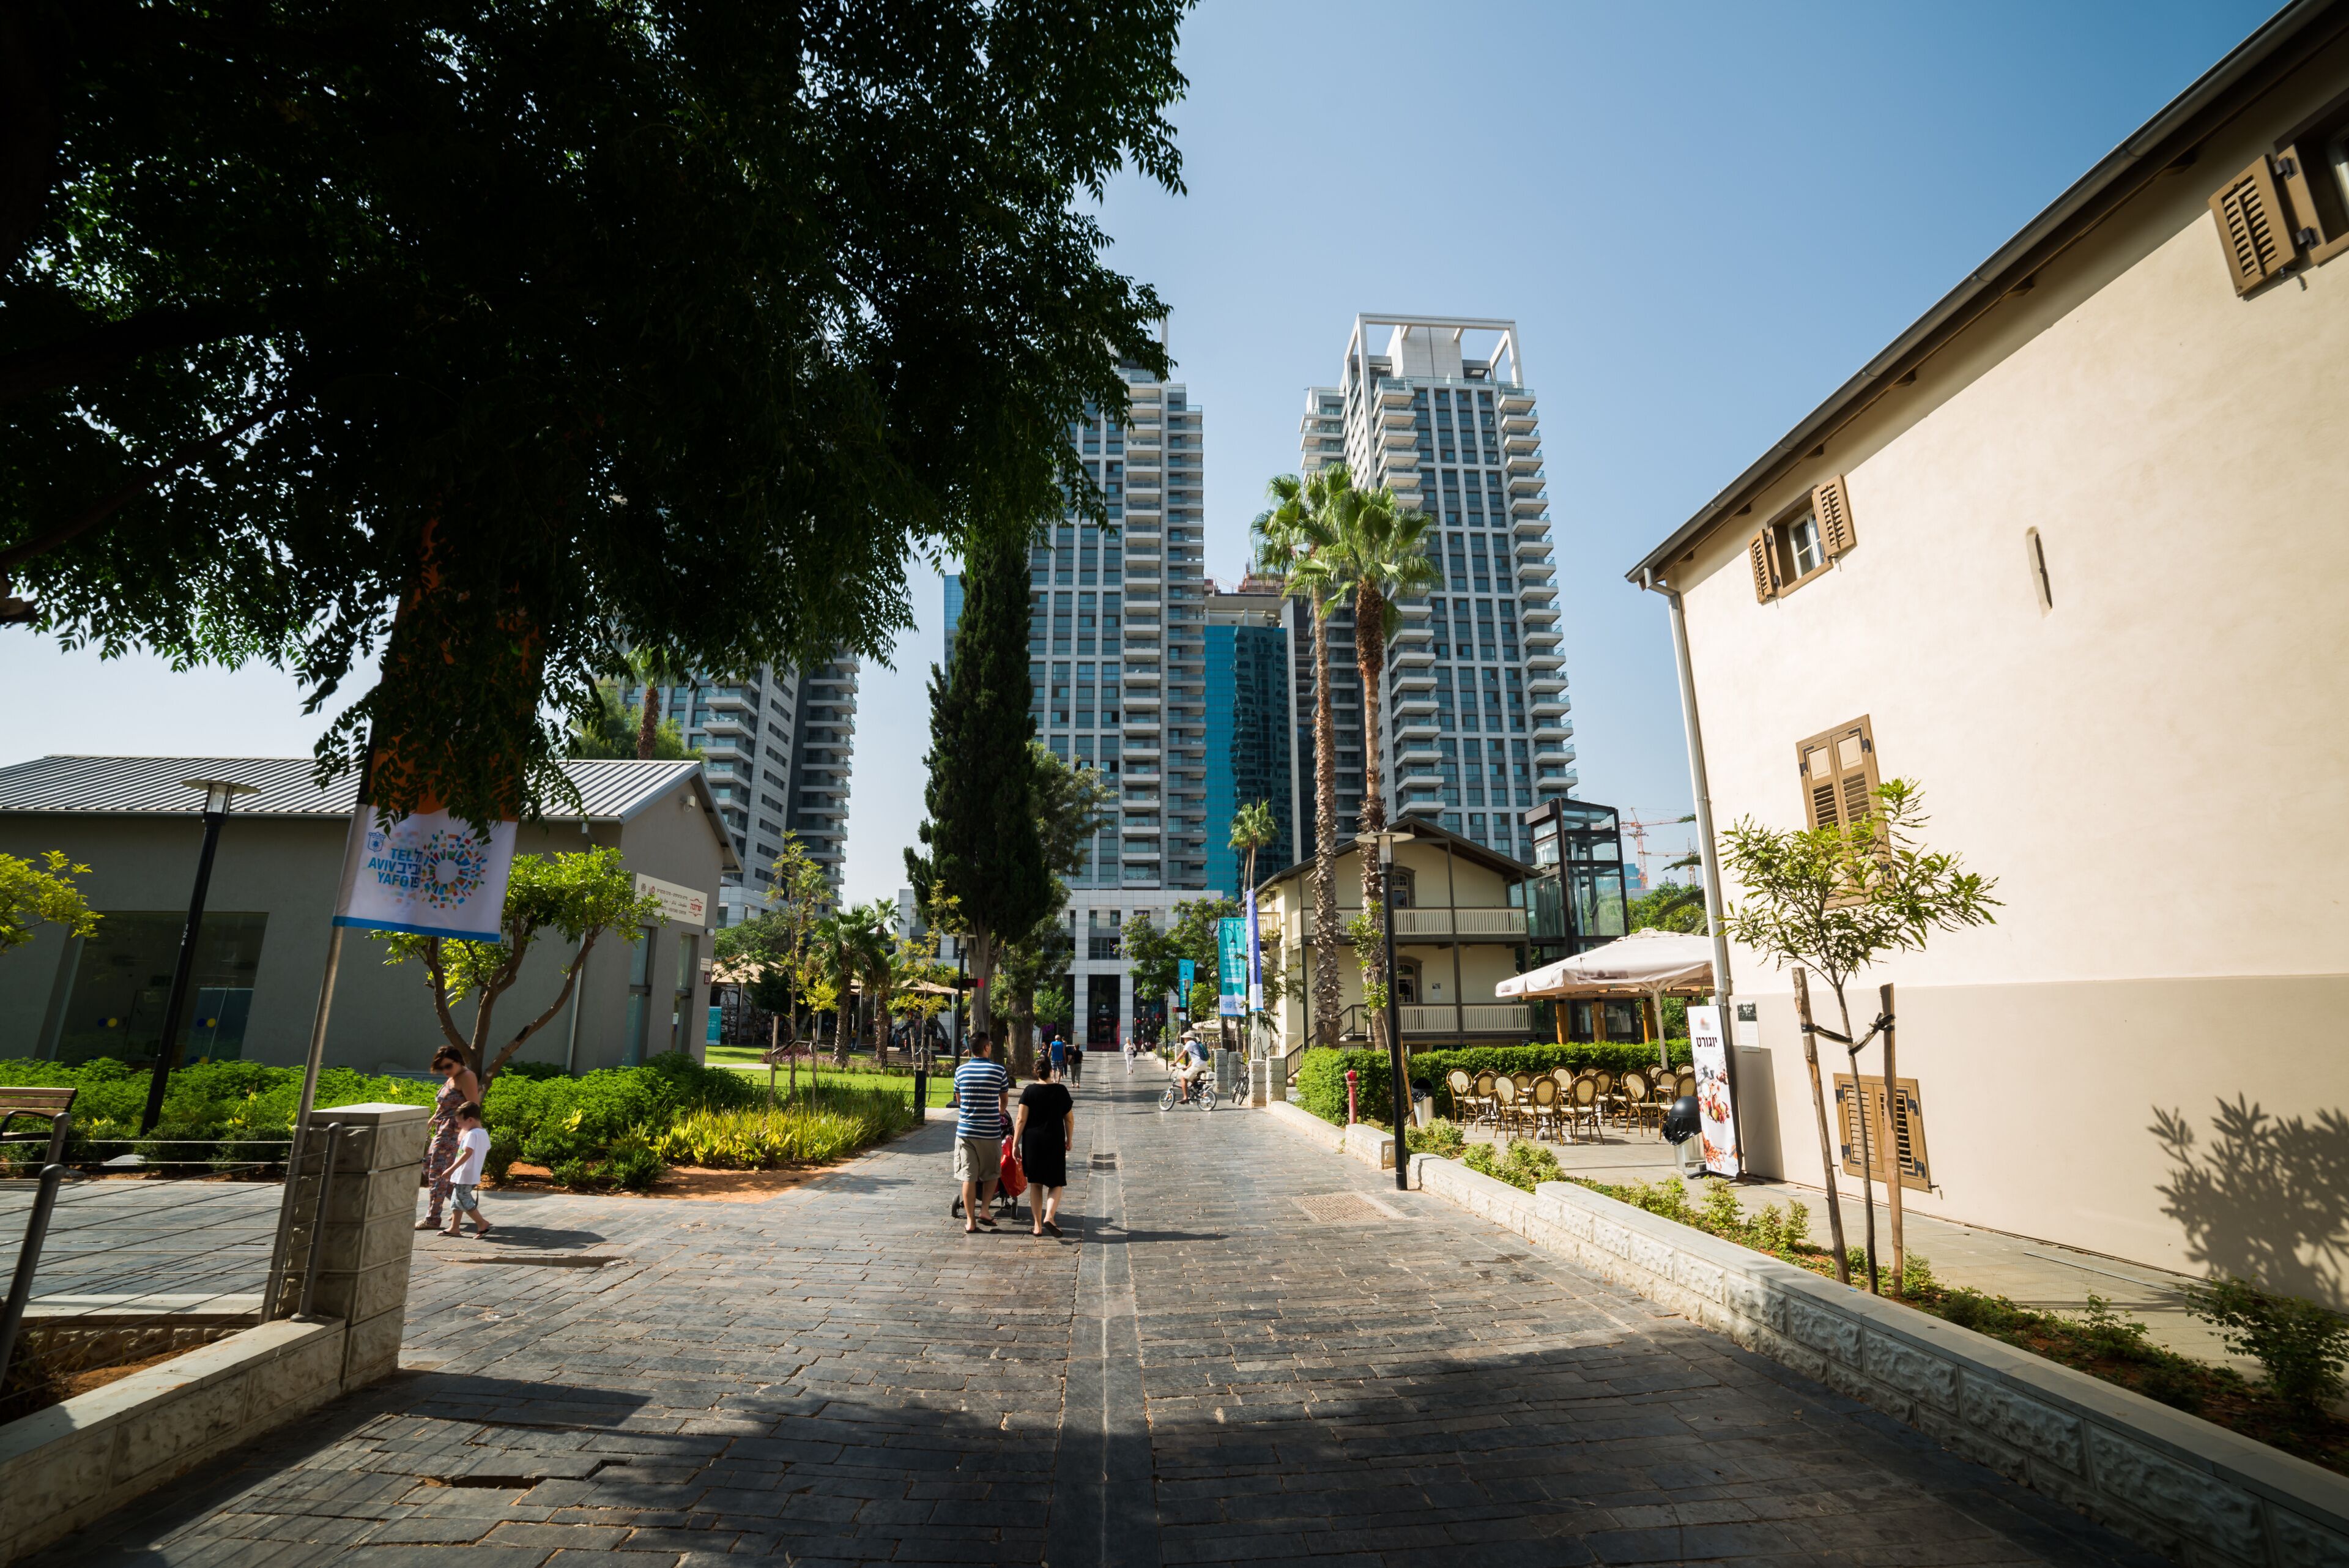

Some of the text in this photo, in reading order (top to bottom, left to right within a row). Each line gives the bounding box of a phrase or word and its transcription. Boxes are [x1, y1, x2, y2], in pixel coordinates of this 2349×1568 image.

[392, 848, 413, 861] TEL
[368, 856, 396, 872] AVIV
[378, 872, 409, 886] YAFO
[1696, 1037, 1718, 1047] יוגורט
